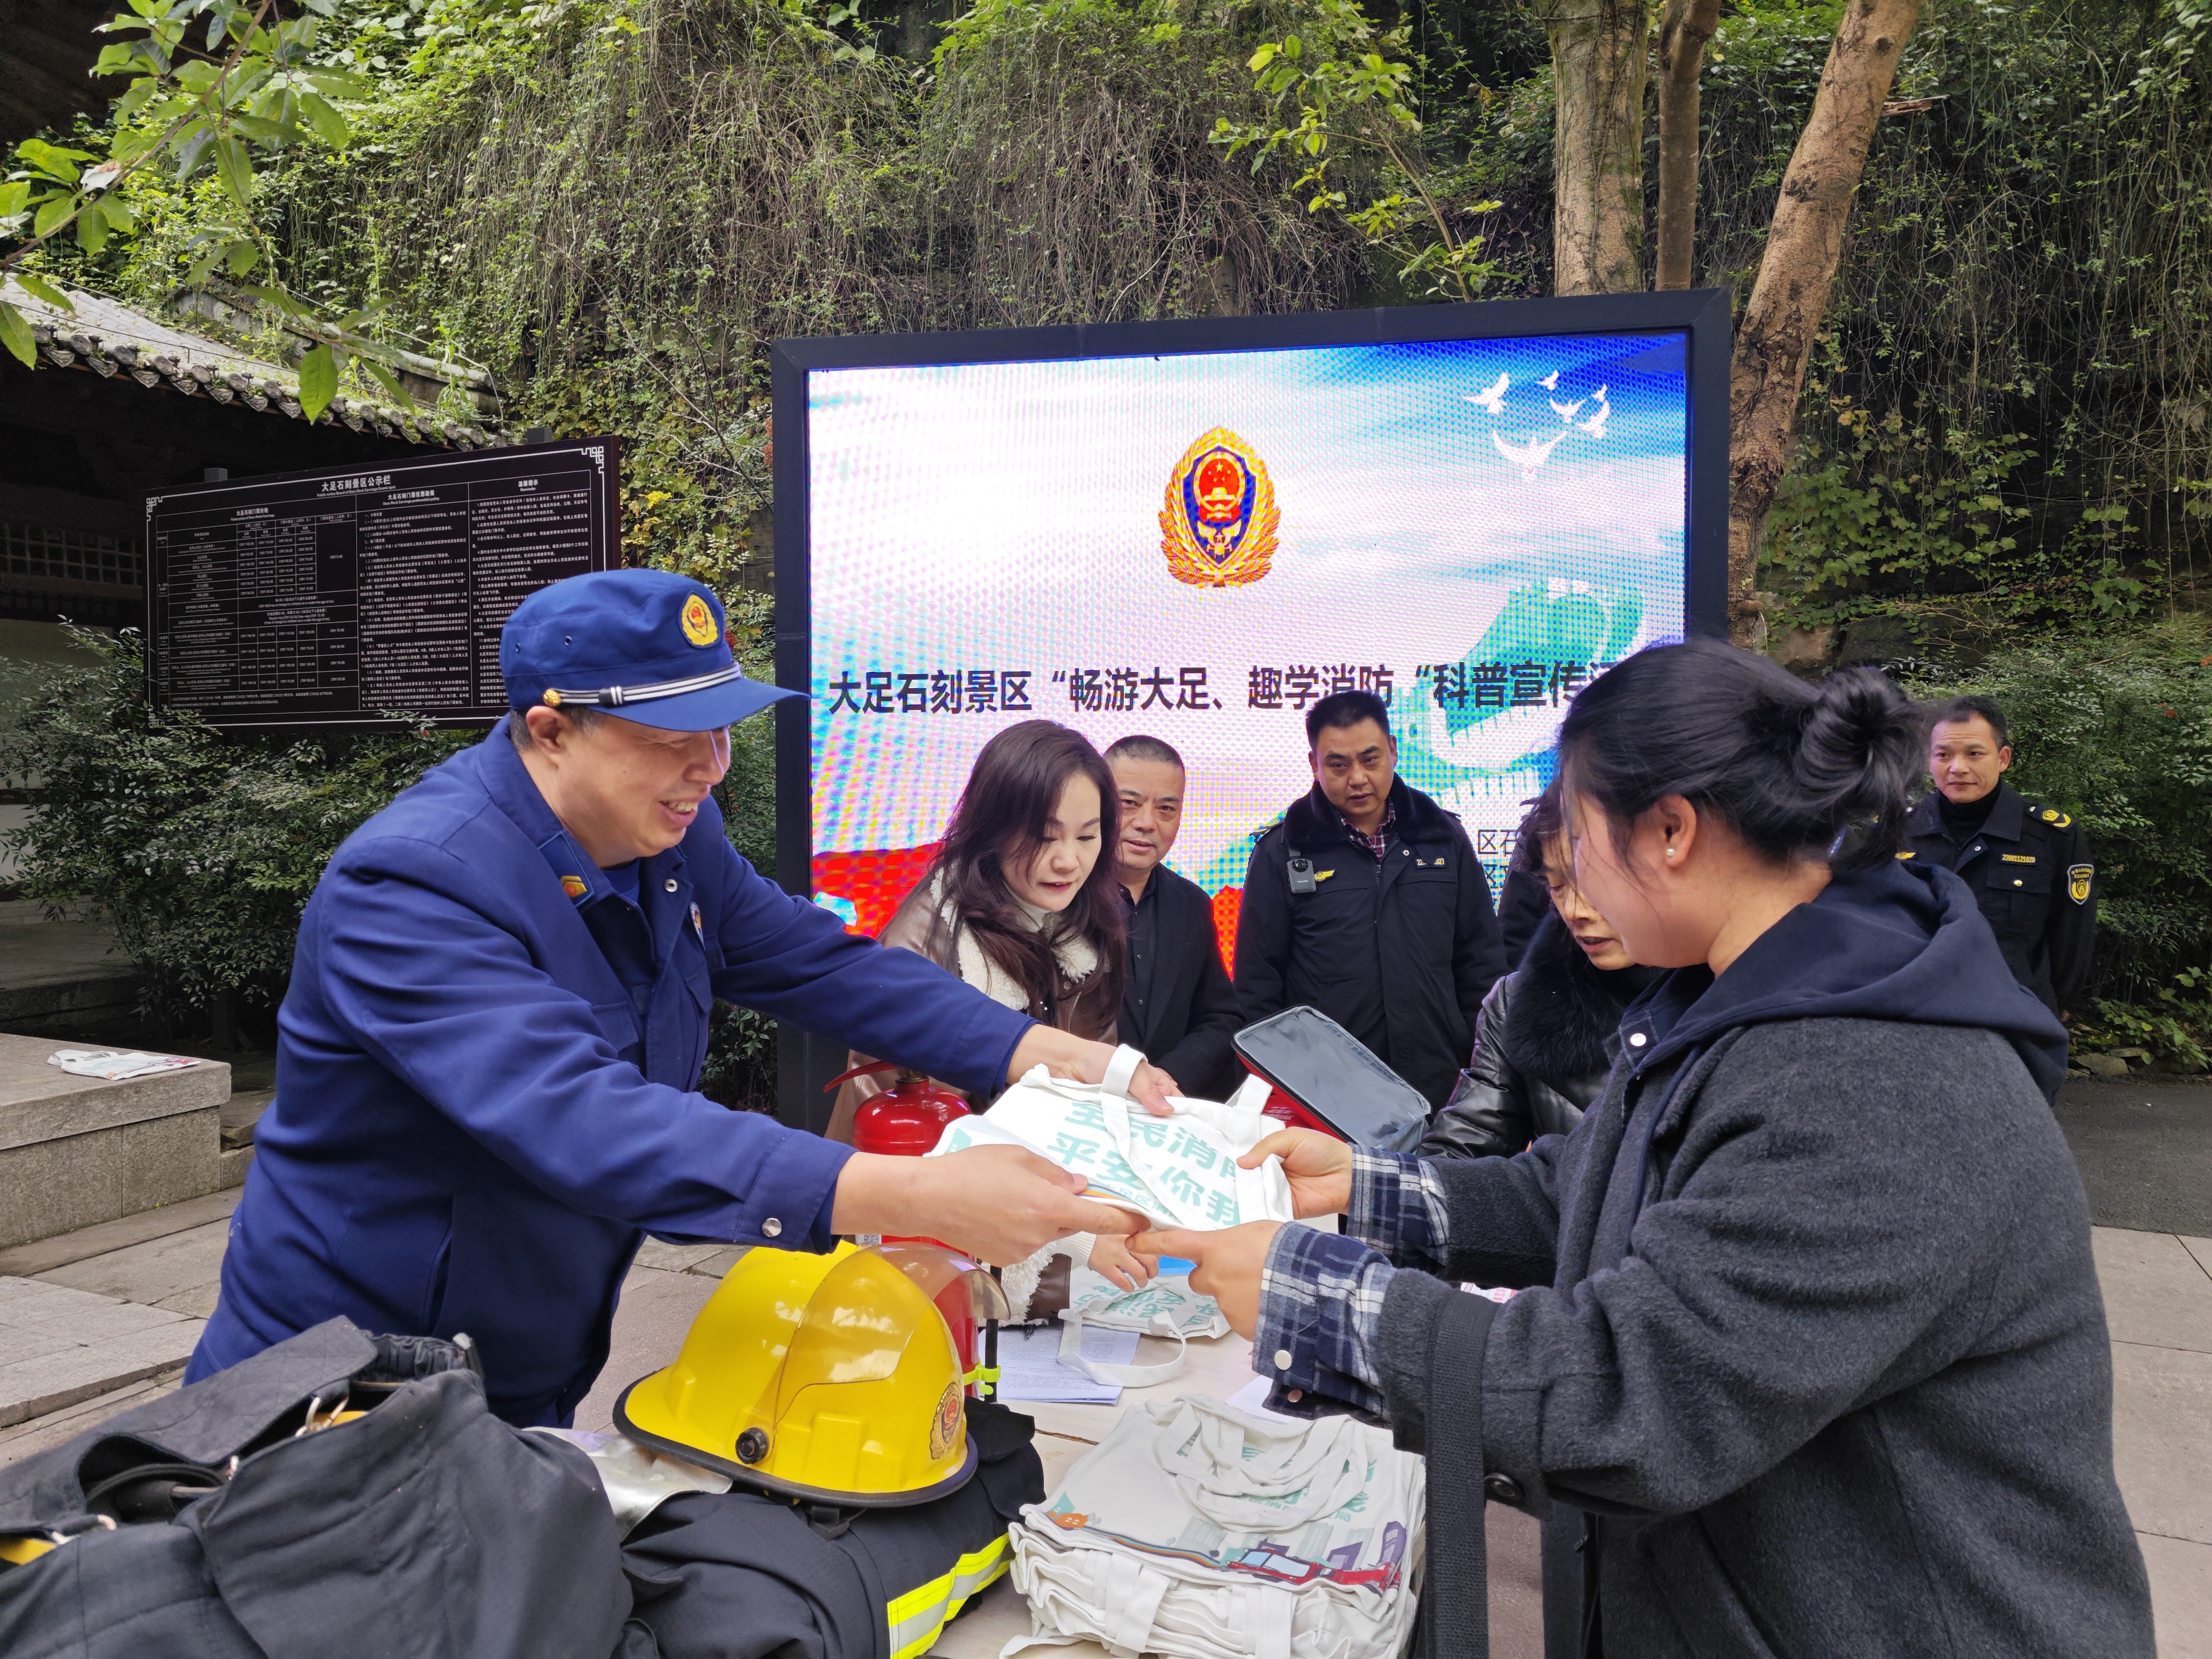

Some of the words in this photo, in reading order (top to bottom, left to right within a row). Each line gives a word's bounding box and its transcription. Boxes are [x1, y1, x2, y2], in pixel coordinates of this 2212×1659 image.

[321, 475, 391, 492] 大足石刻景区公示栏
[388, 490, 435, 500] 大足石刻门票优惠政策
